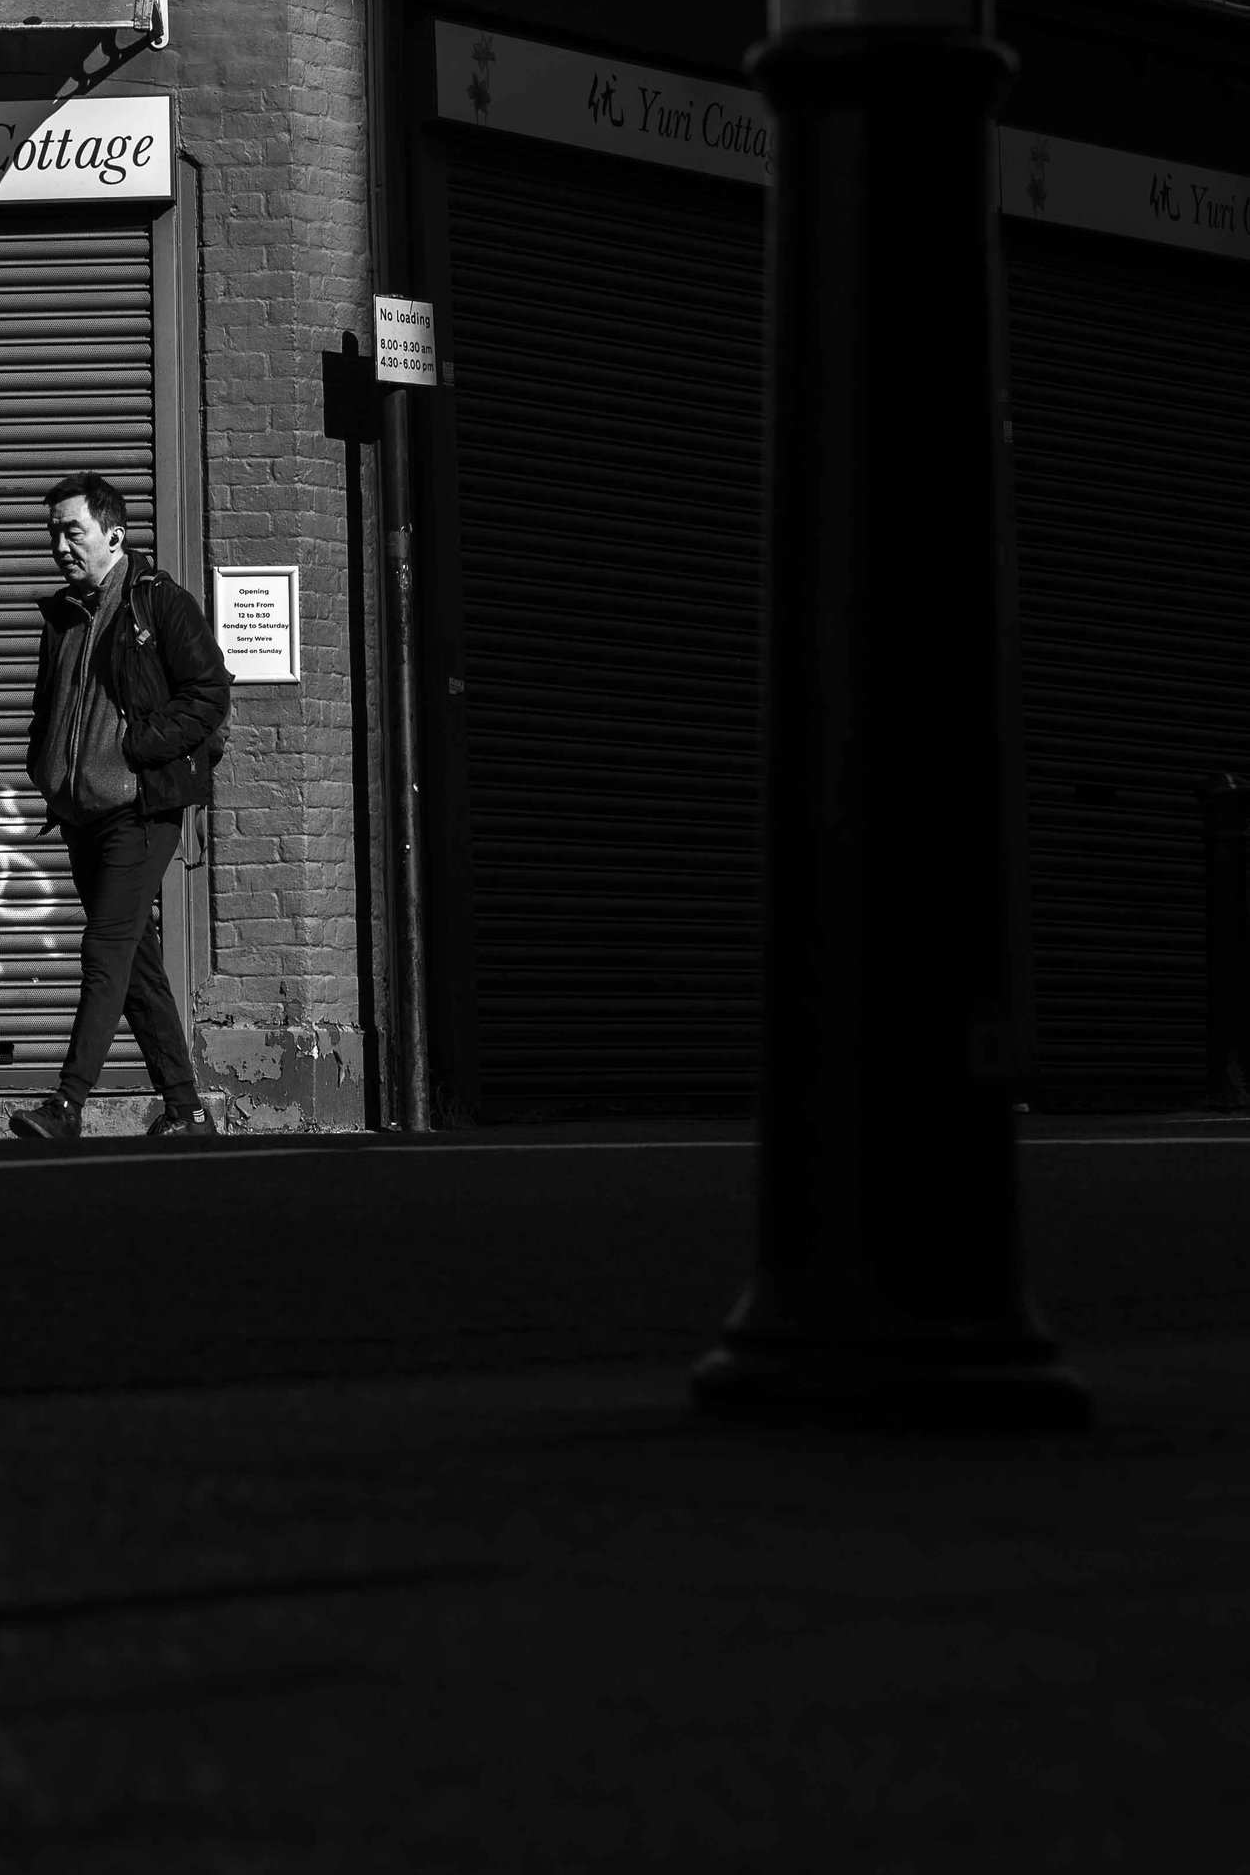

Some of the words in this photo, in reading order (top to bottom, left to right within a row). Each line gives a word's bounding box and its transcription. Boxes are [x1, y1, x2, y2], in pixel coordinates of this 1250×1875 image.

[638, 86, 695, 142] Yuri
[702, 102, 774, 175] Cotta
[1190, 184, 1236, 232] Yuri
[380, 308, 393, 321] No
[396, 310, 431, 328] loading
[421, 345, 433, 355] am
[422, 364, 434, 373] pm
